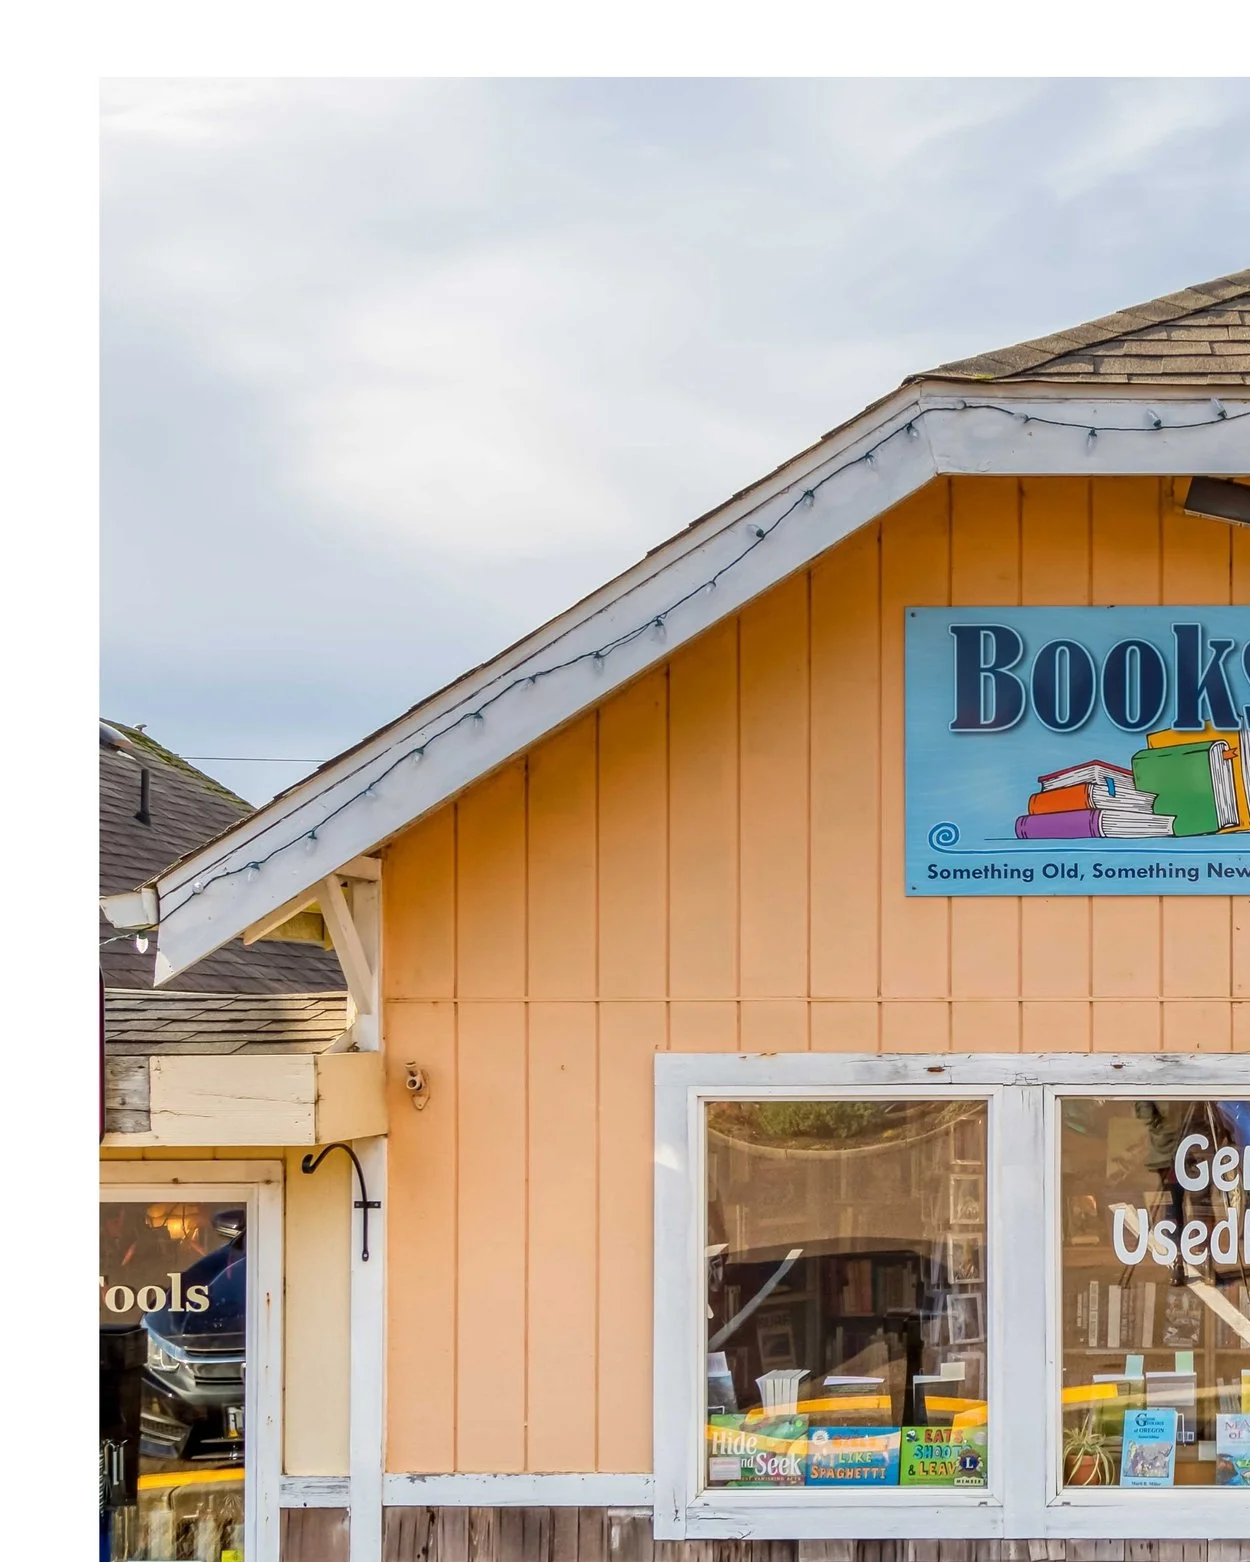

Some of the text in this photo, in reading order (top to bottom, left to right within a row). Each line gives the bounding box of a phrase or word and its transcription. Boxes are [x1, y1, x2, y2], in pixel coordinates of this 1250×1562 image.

[926, 863, 1034, 883] Something
[1042, 862, 1085, 884] Old,
[1092, 862, 1200, 883] Something
[1228, 1430, 1245, 1439] of
[711, 1432, 758, 1455] Hide
[754, 1451, 802, 1476] Seek
[838, 1451, 873, 1463] LIKE
[810, 1464, 887, 1479] SPAGHETTI
[908, 1461, 957, 1476] & LEAV
